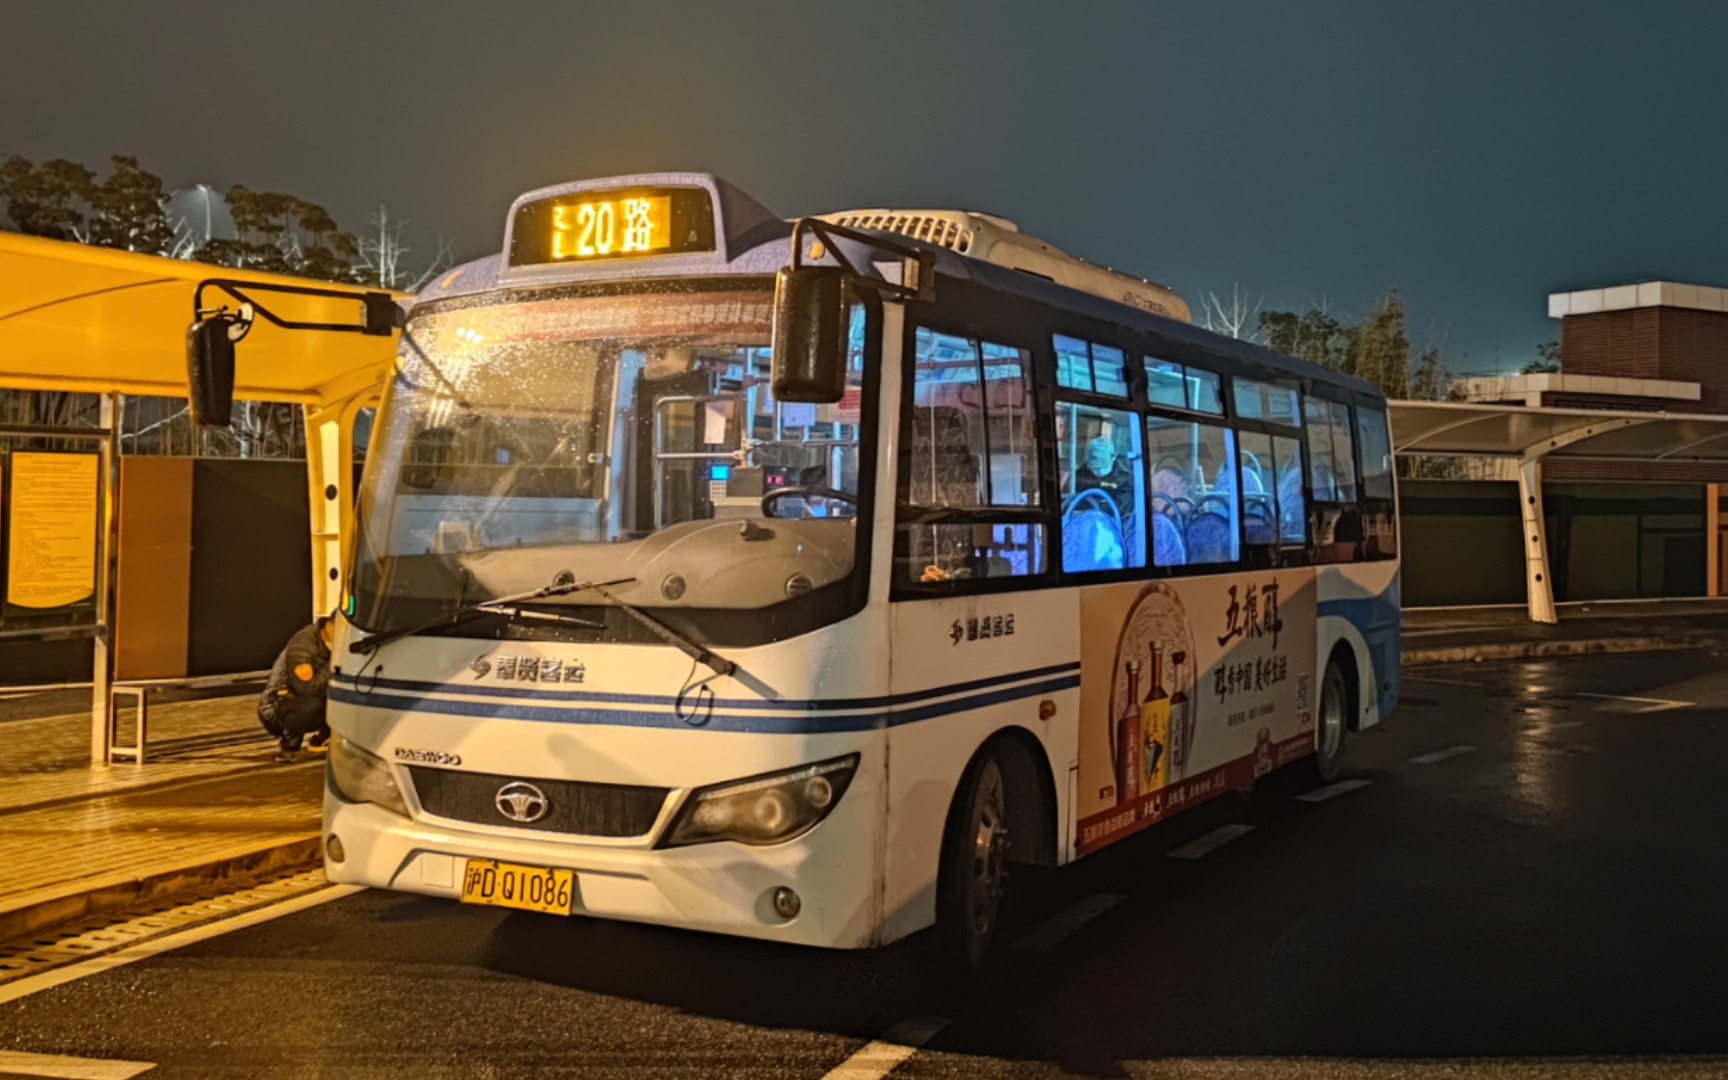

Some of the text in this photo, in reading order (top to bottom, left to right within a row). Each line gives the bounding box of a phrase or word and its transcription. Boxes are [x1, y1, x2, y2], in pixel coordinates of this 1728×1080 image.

[1216, 576, 1284, 651] 五粮醇
[394, 747, 463, 767] DAEWOO
